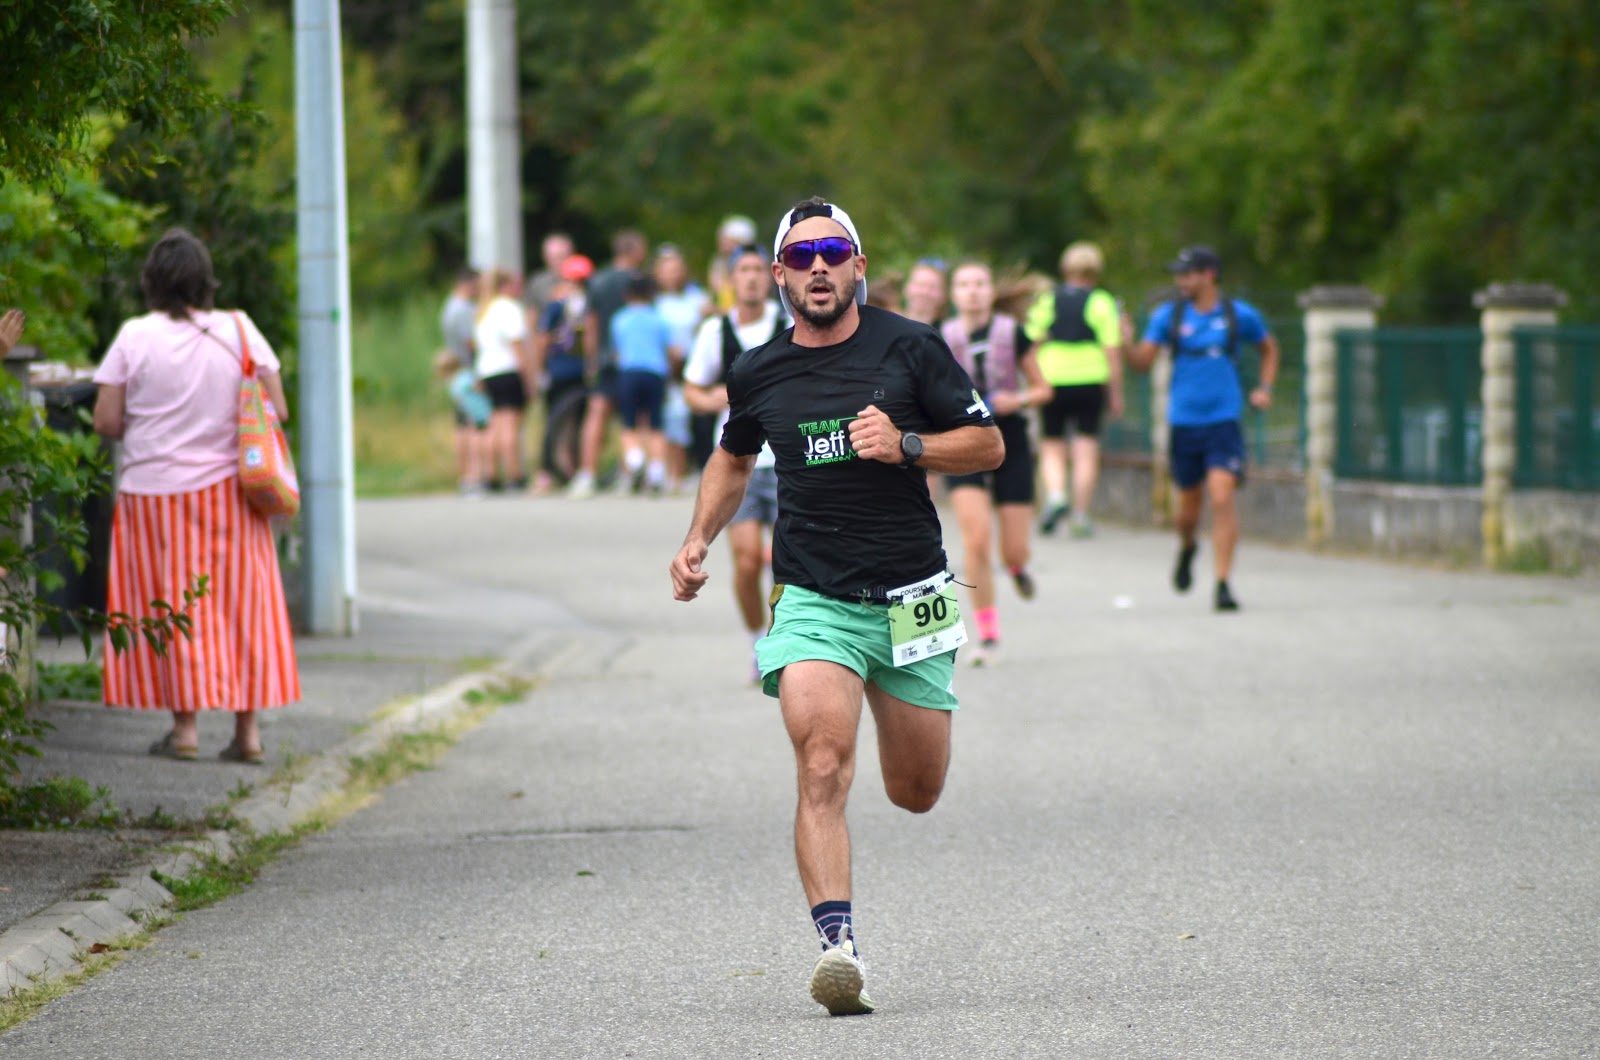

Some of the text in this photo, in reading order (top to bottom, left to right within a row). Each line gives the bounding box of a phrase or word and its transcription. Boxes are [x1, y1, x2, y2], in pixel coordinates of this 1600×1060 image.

[797, 419, 840, 436] TEAM
[803, 430, 846, 455] Jeff
[913, 596, 947, 628] 90
